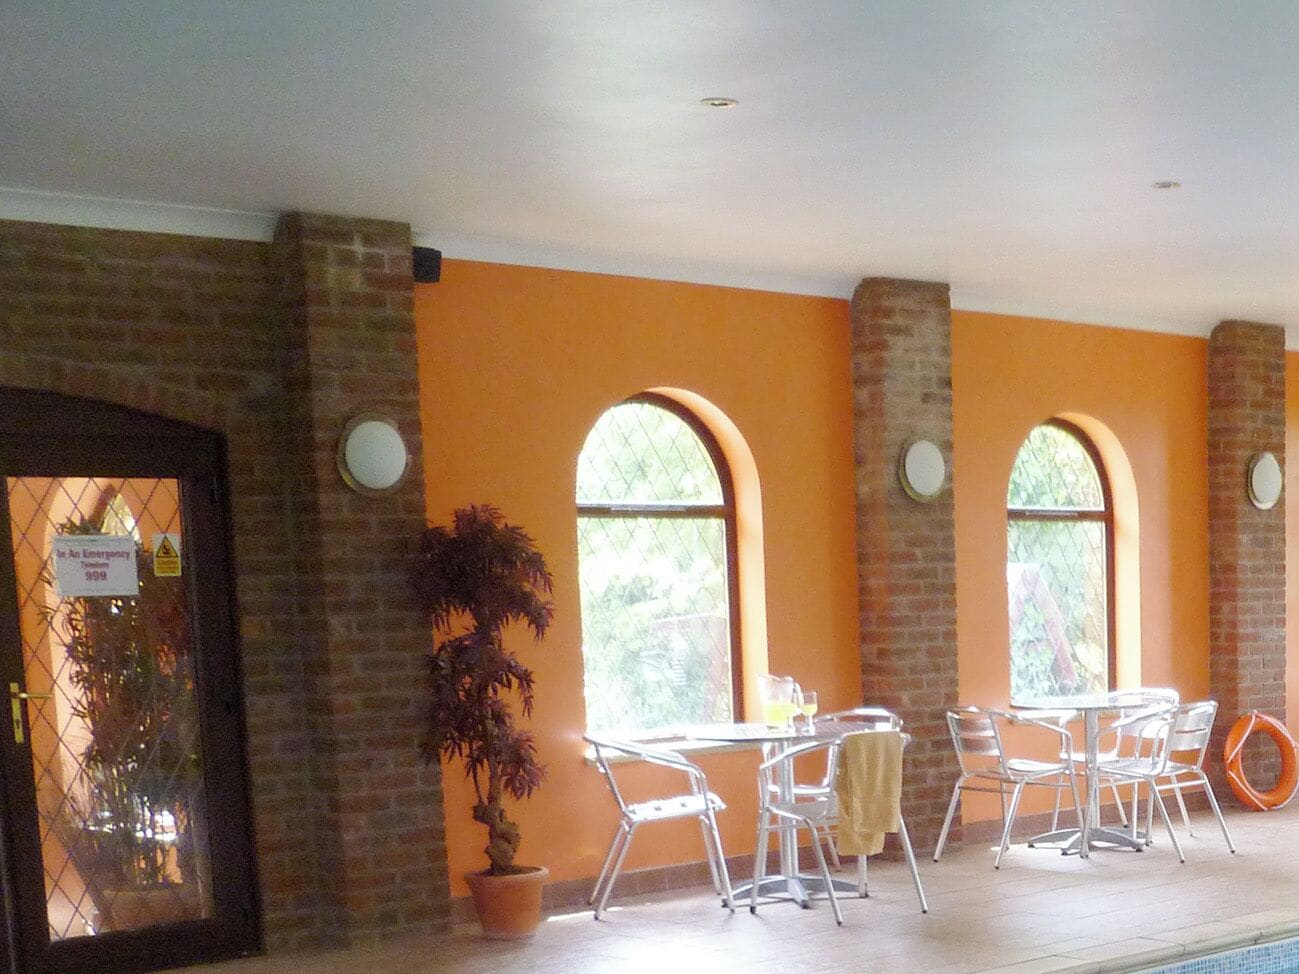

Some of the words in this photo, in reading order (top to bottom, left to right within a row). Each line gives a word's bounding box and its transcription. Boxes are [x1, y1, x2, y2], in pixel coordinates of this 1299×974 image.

[57, 549, 66, 558] In
[69, 549, 80, 558] An
[82, 549, 131, 561] Emergency
[85, 570, 107, 581] 999
